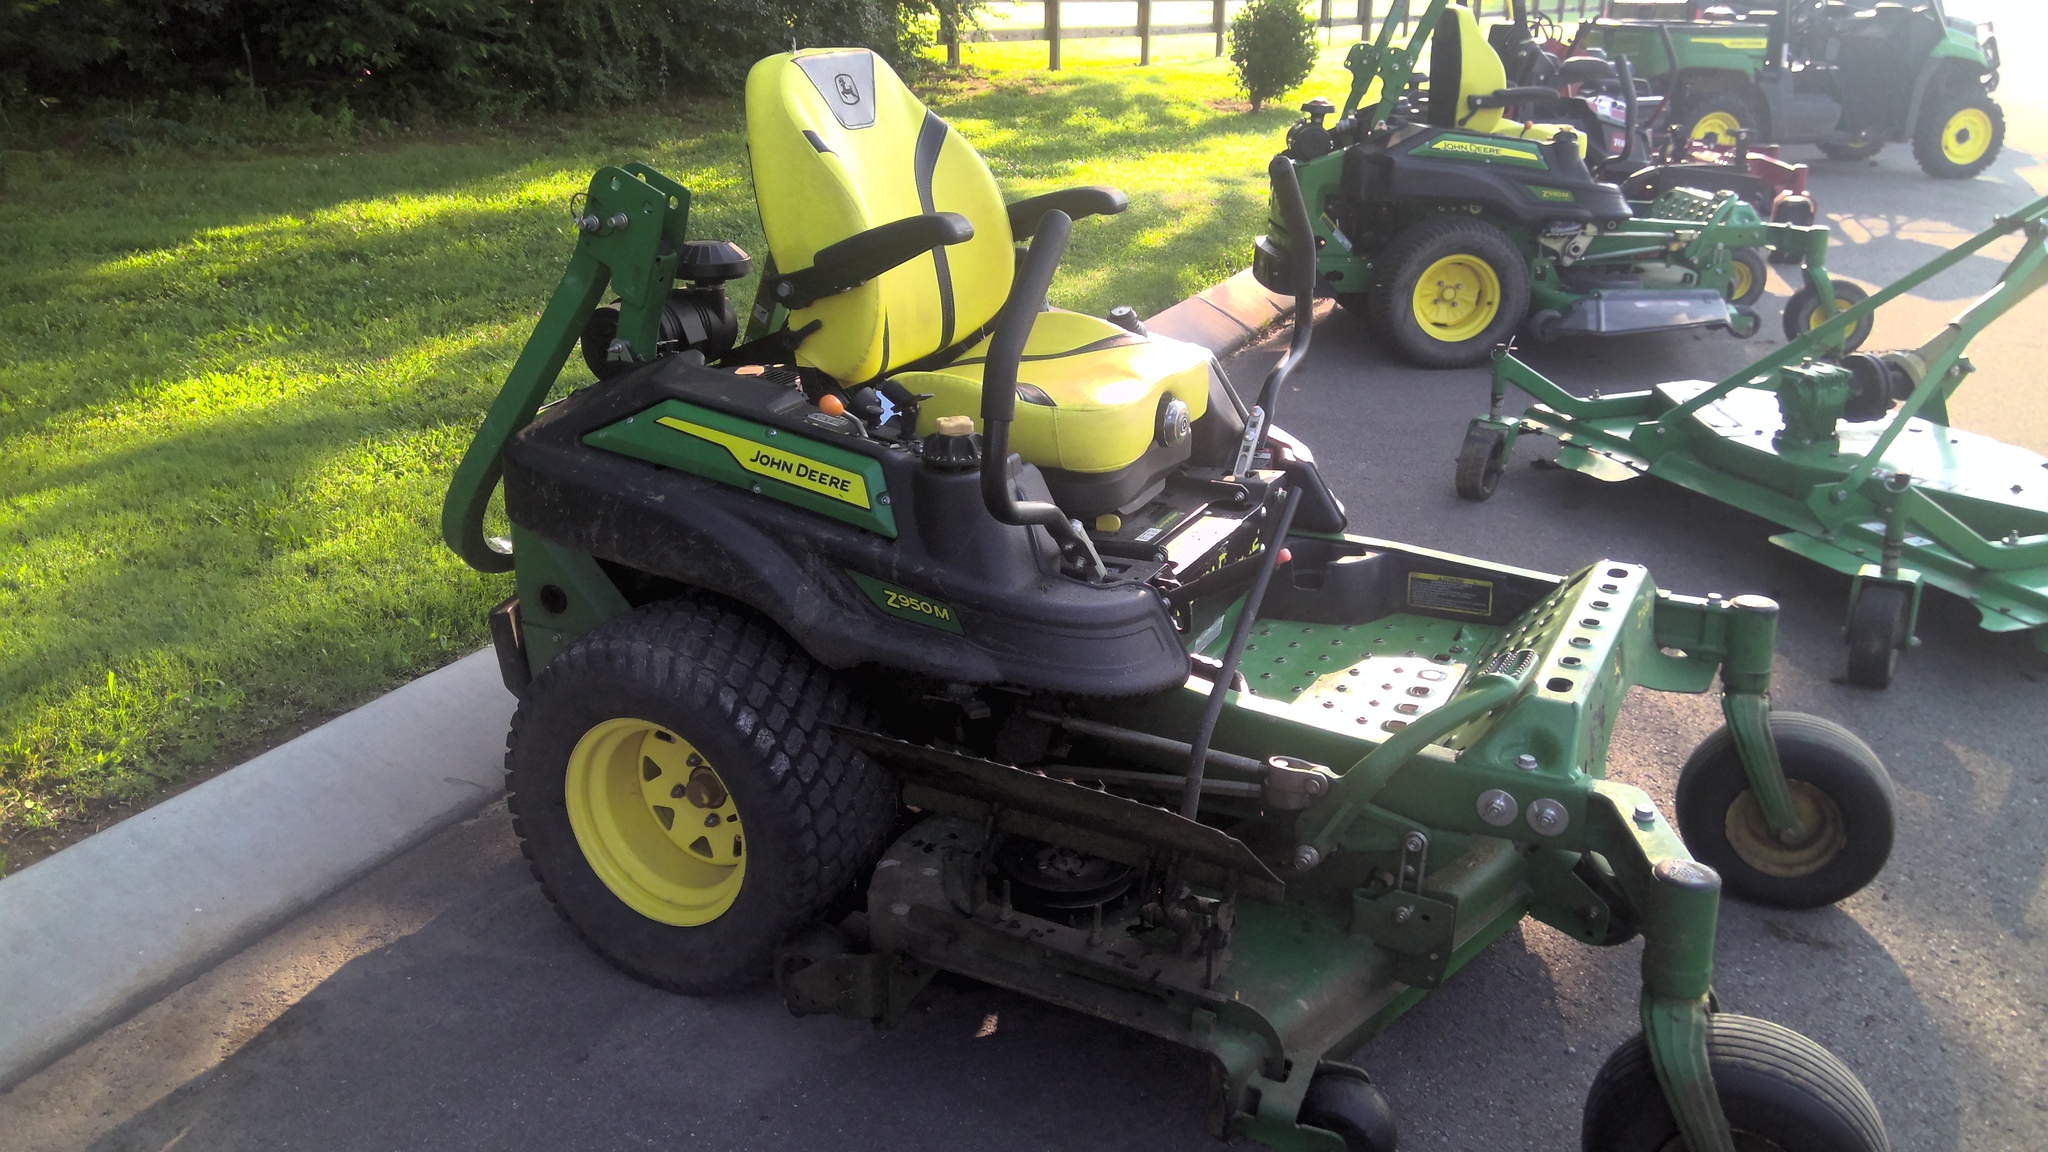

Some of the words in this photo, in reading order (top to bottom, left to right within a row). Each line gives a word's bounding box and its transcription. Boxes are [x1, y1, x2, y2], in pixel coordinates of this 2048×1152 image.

[1441, 142, 1468, 151] JOHN
[1470, 144, 1500, 155] DEERE
[749, 450, 794, 474] JOHN
[795, 463, 852, 493] DEERE
[883, 589, 951, 621] Z950M
